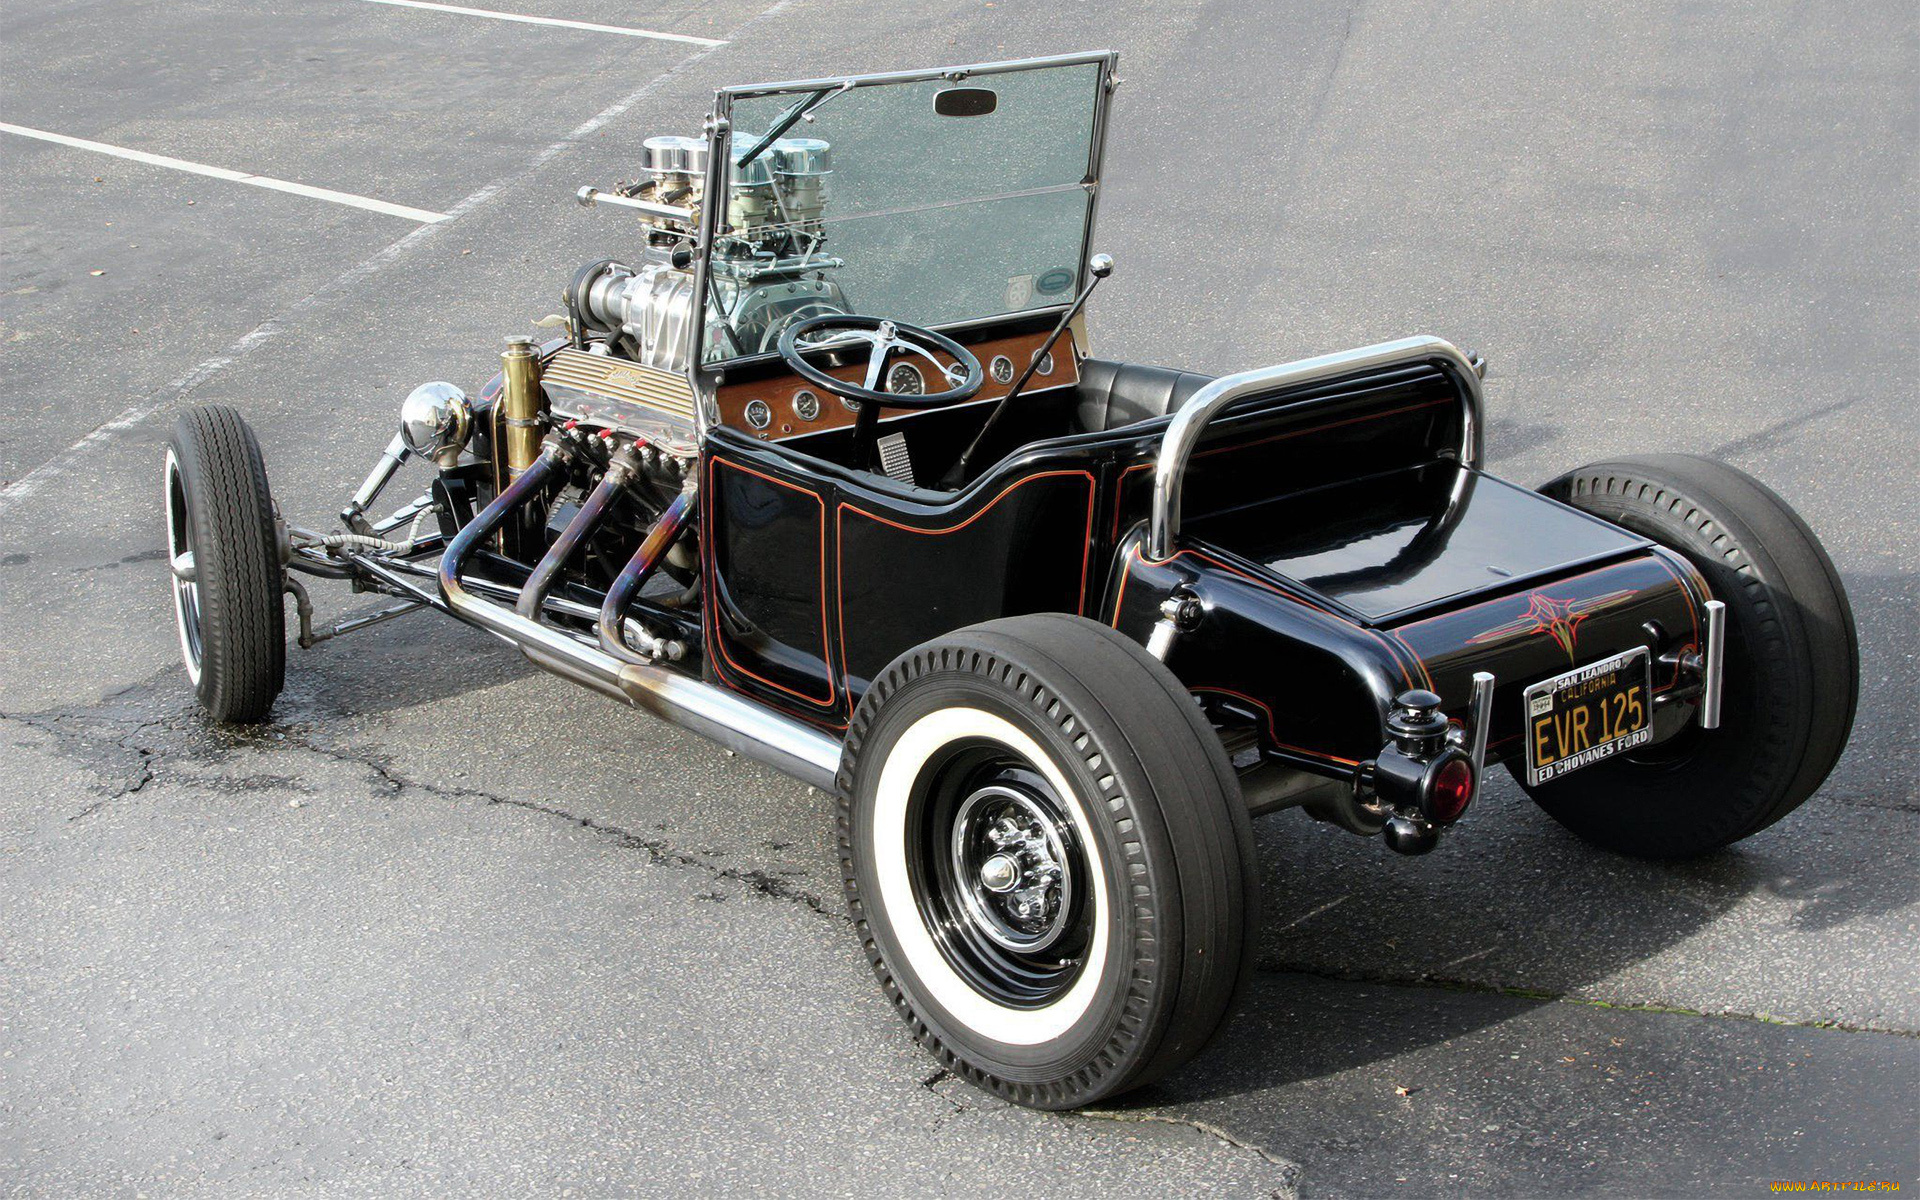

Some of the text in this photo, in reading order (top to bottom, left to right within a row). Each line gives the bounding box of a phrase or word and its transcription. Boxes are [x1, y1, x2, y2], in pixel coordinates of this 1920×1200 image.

[1557, 659, 1623, 689] SAN LEANDRO
[1561, 673, 1616, 703] CALIFORNIA
[1535, 686, 1643, 767] EVR 125
[1538, 730, 1648, 782] ED CHOVANES FORD
